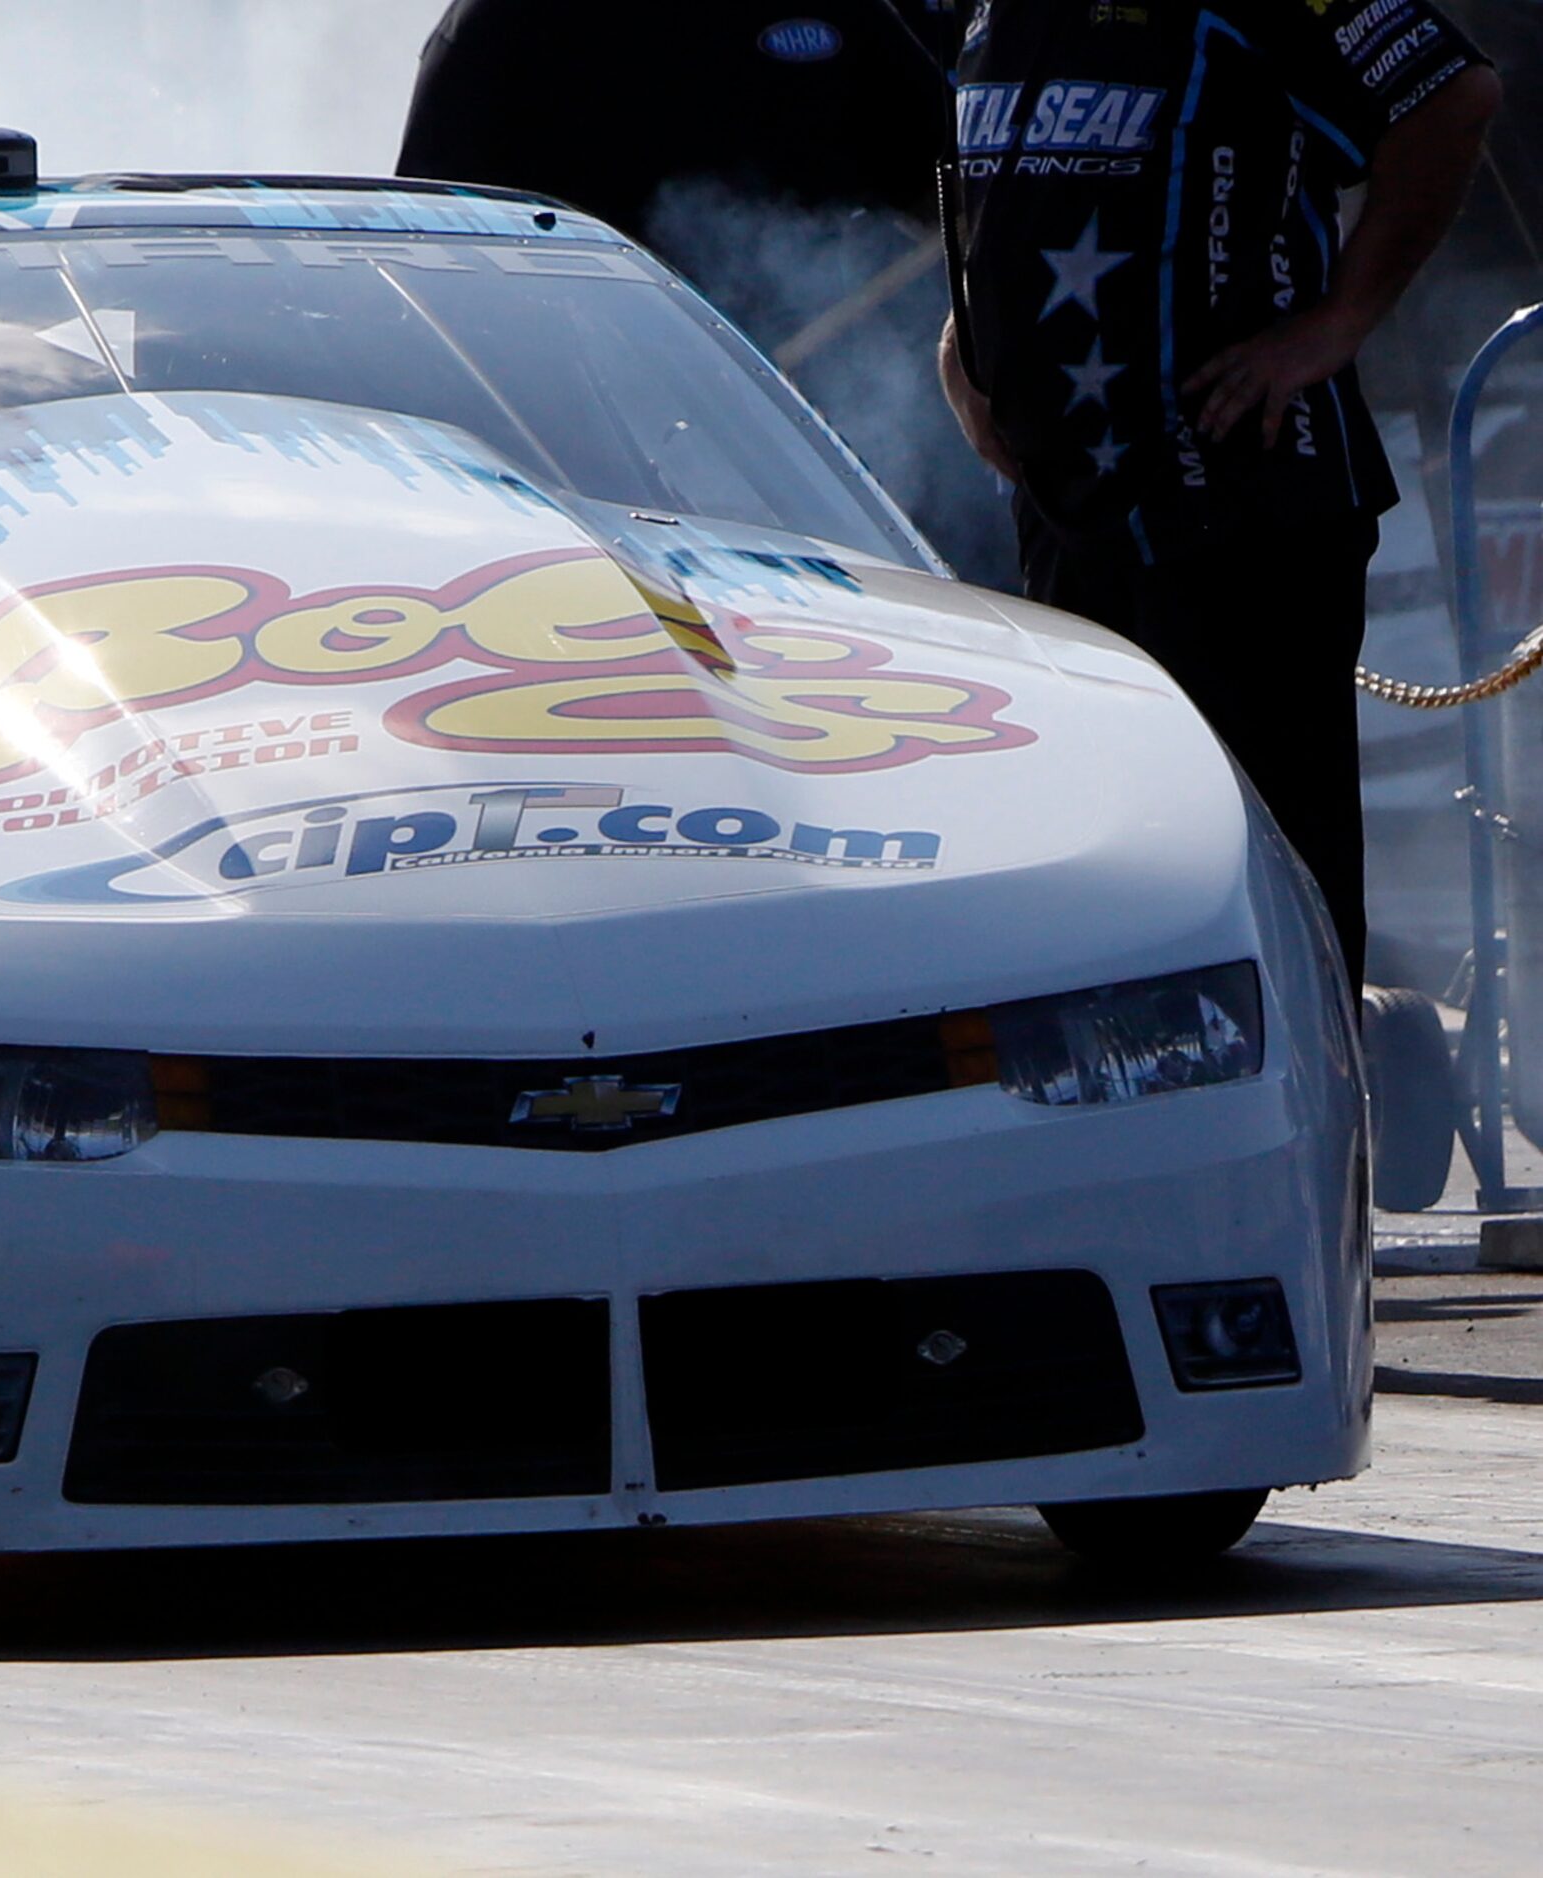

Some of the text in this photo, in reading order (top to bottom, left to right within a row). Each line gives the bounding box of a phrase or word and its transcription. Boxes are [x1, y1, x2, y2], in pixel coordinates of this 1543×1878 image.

[771, 25, 832, 53] NHRA
[1362, 18, 1440, 89] CURRY'S
[1024, 83, 1161, 149] SEAL
[1013, 156, 1143, 175] RINGS
[394, 845, 587, 869] California
[599, 844, 729, 858] Import
